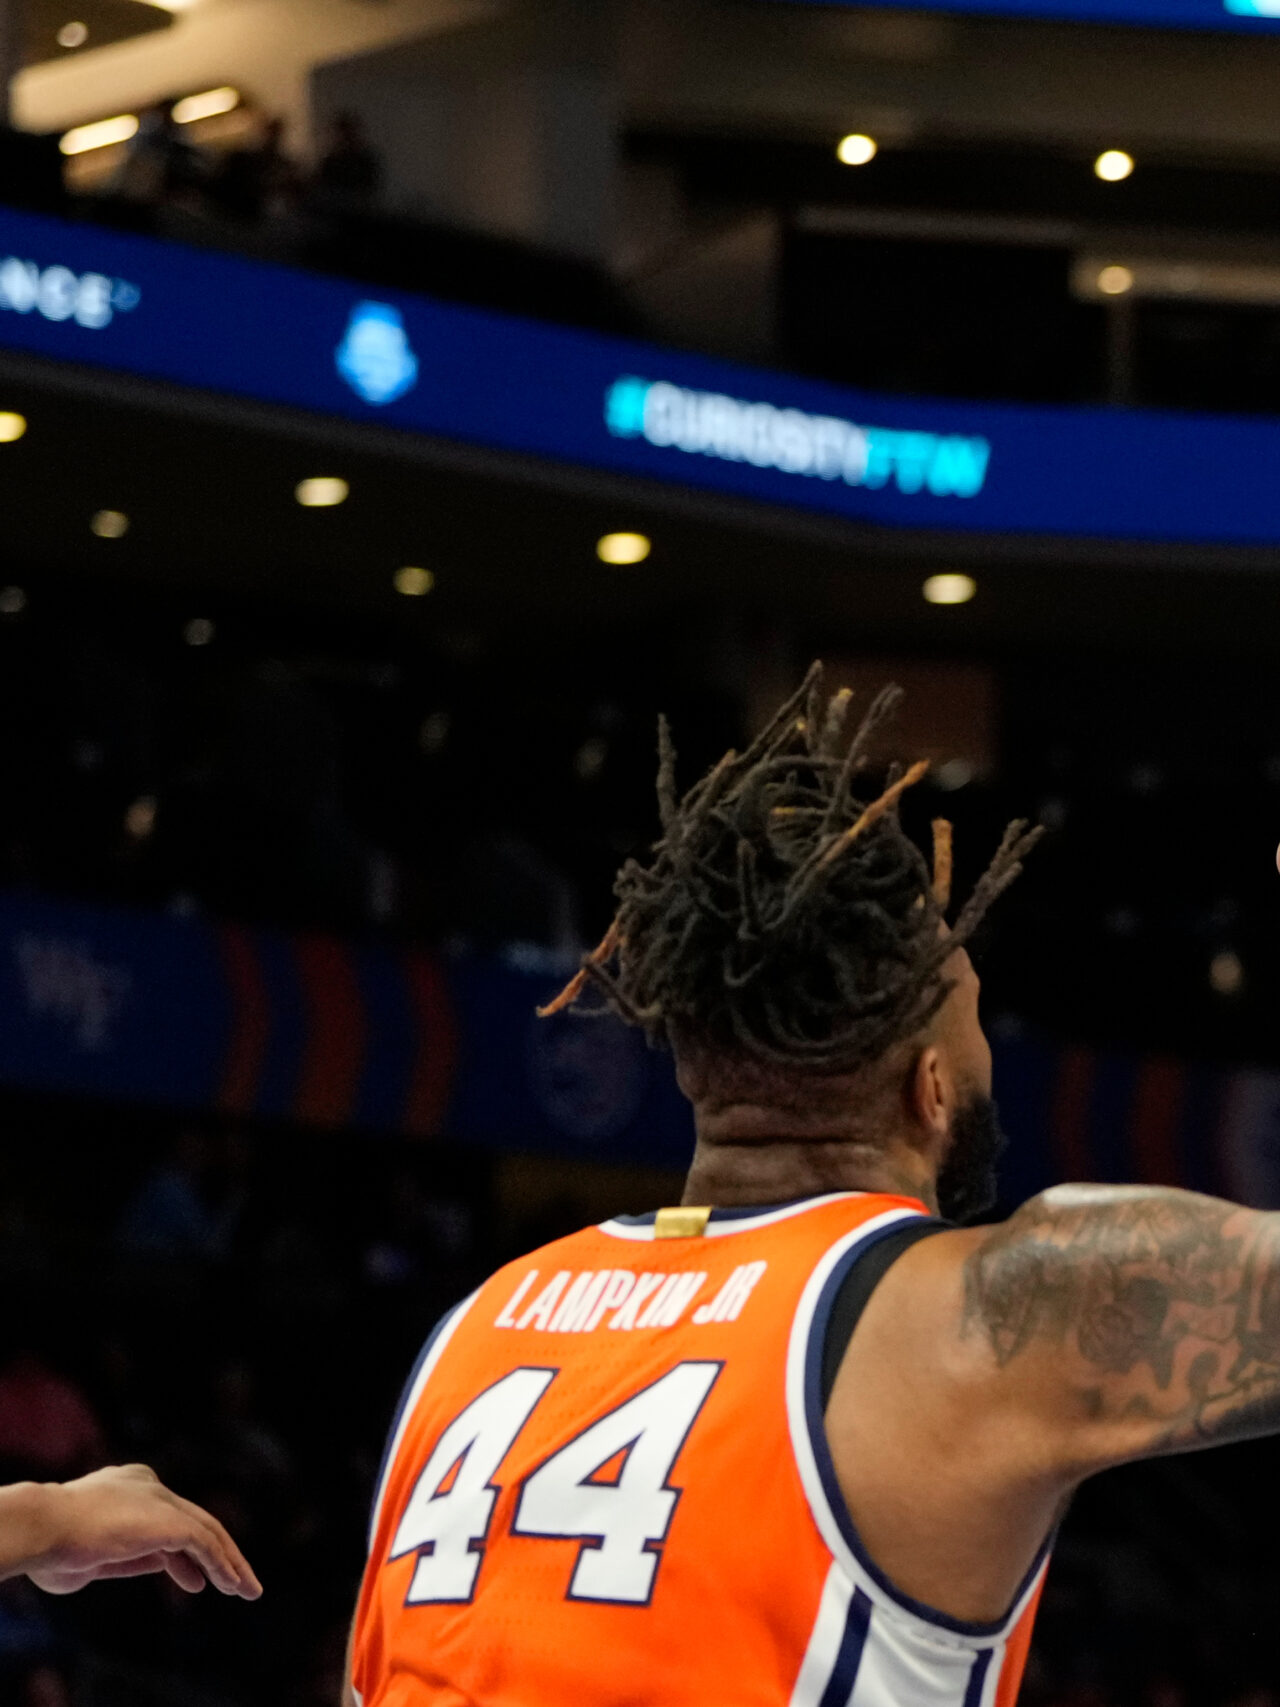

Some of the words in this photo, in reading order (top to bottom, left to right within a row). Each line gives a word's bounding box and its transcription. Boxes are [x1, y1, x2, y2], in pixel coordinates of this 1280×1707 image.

[494, 1269, 708, 1333] LAMPKIN
[692, 1260, 768, 1325] JR
[386, 1360, 727, 1607] 44
